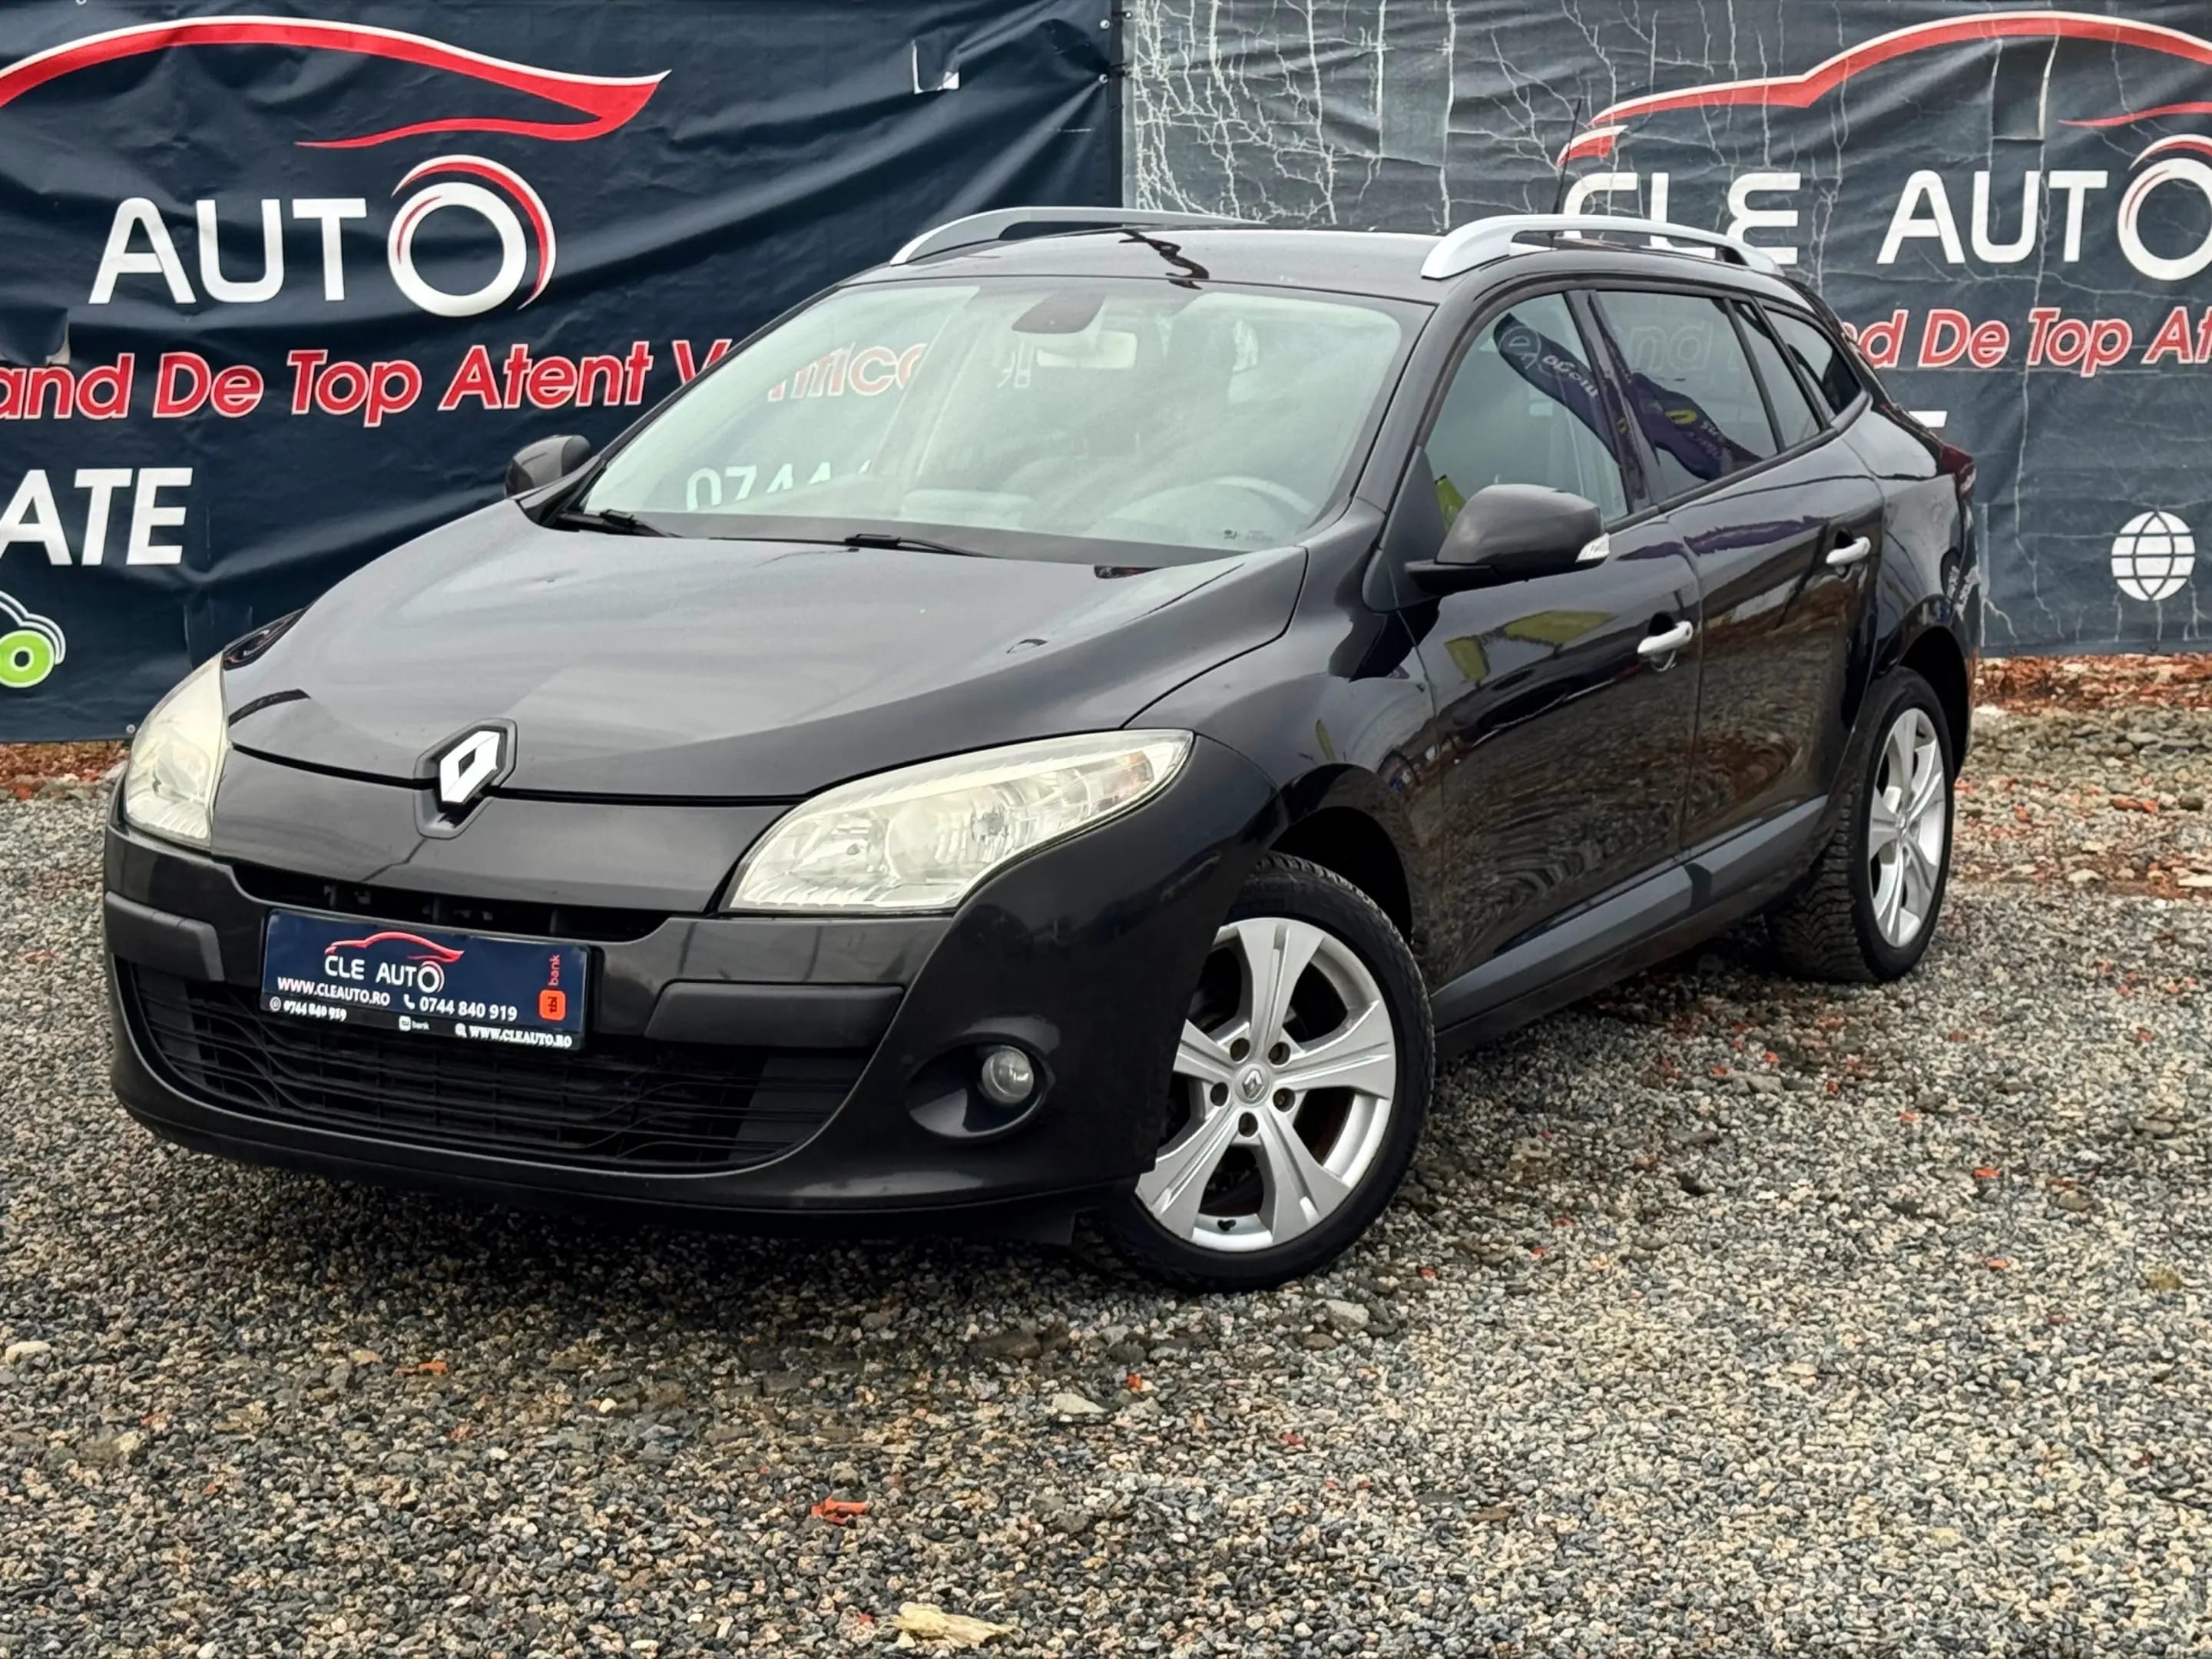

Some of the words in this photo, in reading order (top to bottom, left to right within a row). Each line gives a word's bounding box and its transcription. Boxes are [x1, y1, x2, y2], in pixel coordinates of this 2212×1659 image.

[1562, 172, 1801, 265] CLE
[1876, 157, 2212, 280] AUTO
[88, 182, 527, 316] AUTO
[1917, 309, 2010, 369] De
[2028, 307, 2134, 378] Top
[153, 352, 263, 418] De
[286, 349, 422, 428] Top
[438, 341, 653, 411] Atent
[324, 955, 365, 981] CLE
[375, 962, 443, 994] AUTO
[547, 954, 561, 986] bank
[277, 976, 391, 1006] WWW.CLEAUTO.RO
[283, 1000, 308, 1016] 0744
[308, 1002, 327, 1018] 840
[328, 1006, 347, 1022] 919
[419, 996, 455, 1015] 0744
[458, 1001, 486, 1018] 840
[489, 1005, 518, 1022] 919
[469, 1025, 573, 1048] WWW.CLEAUTO.RO
